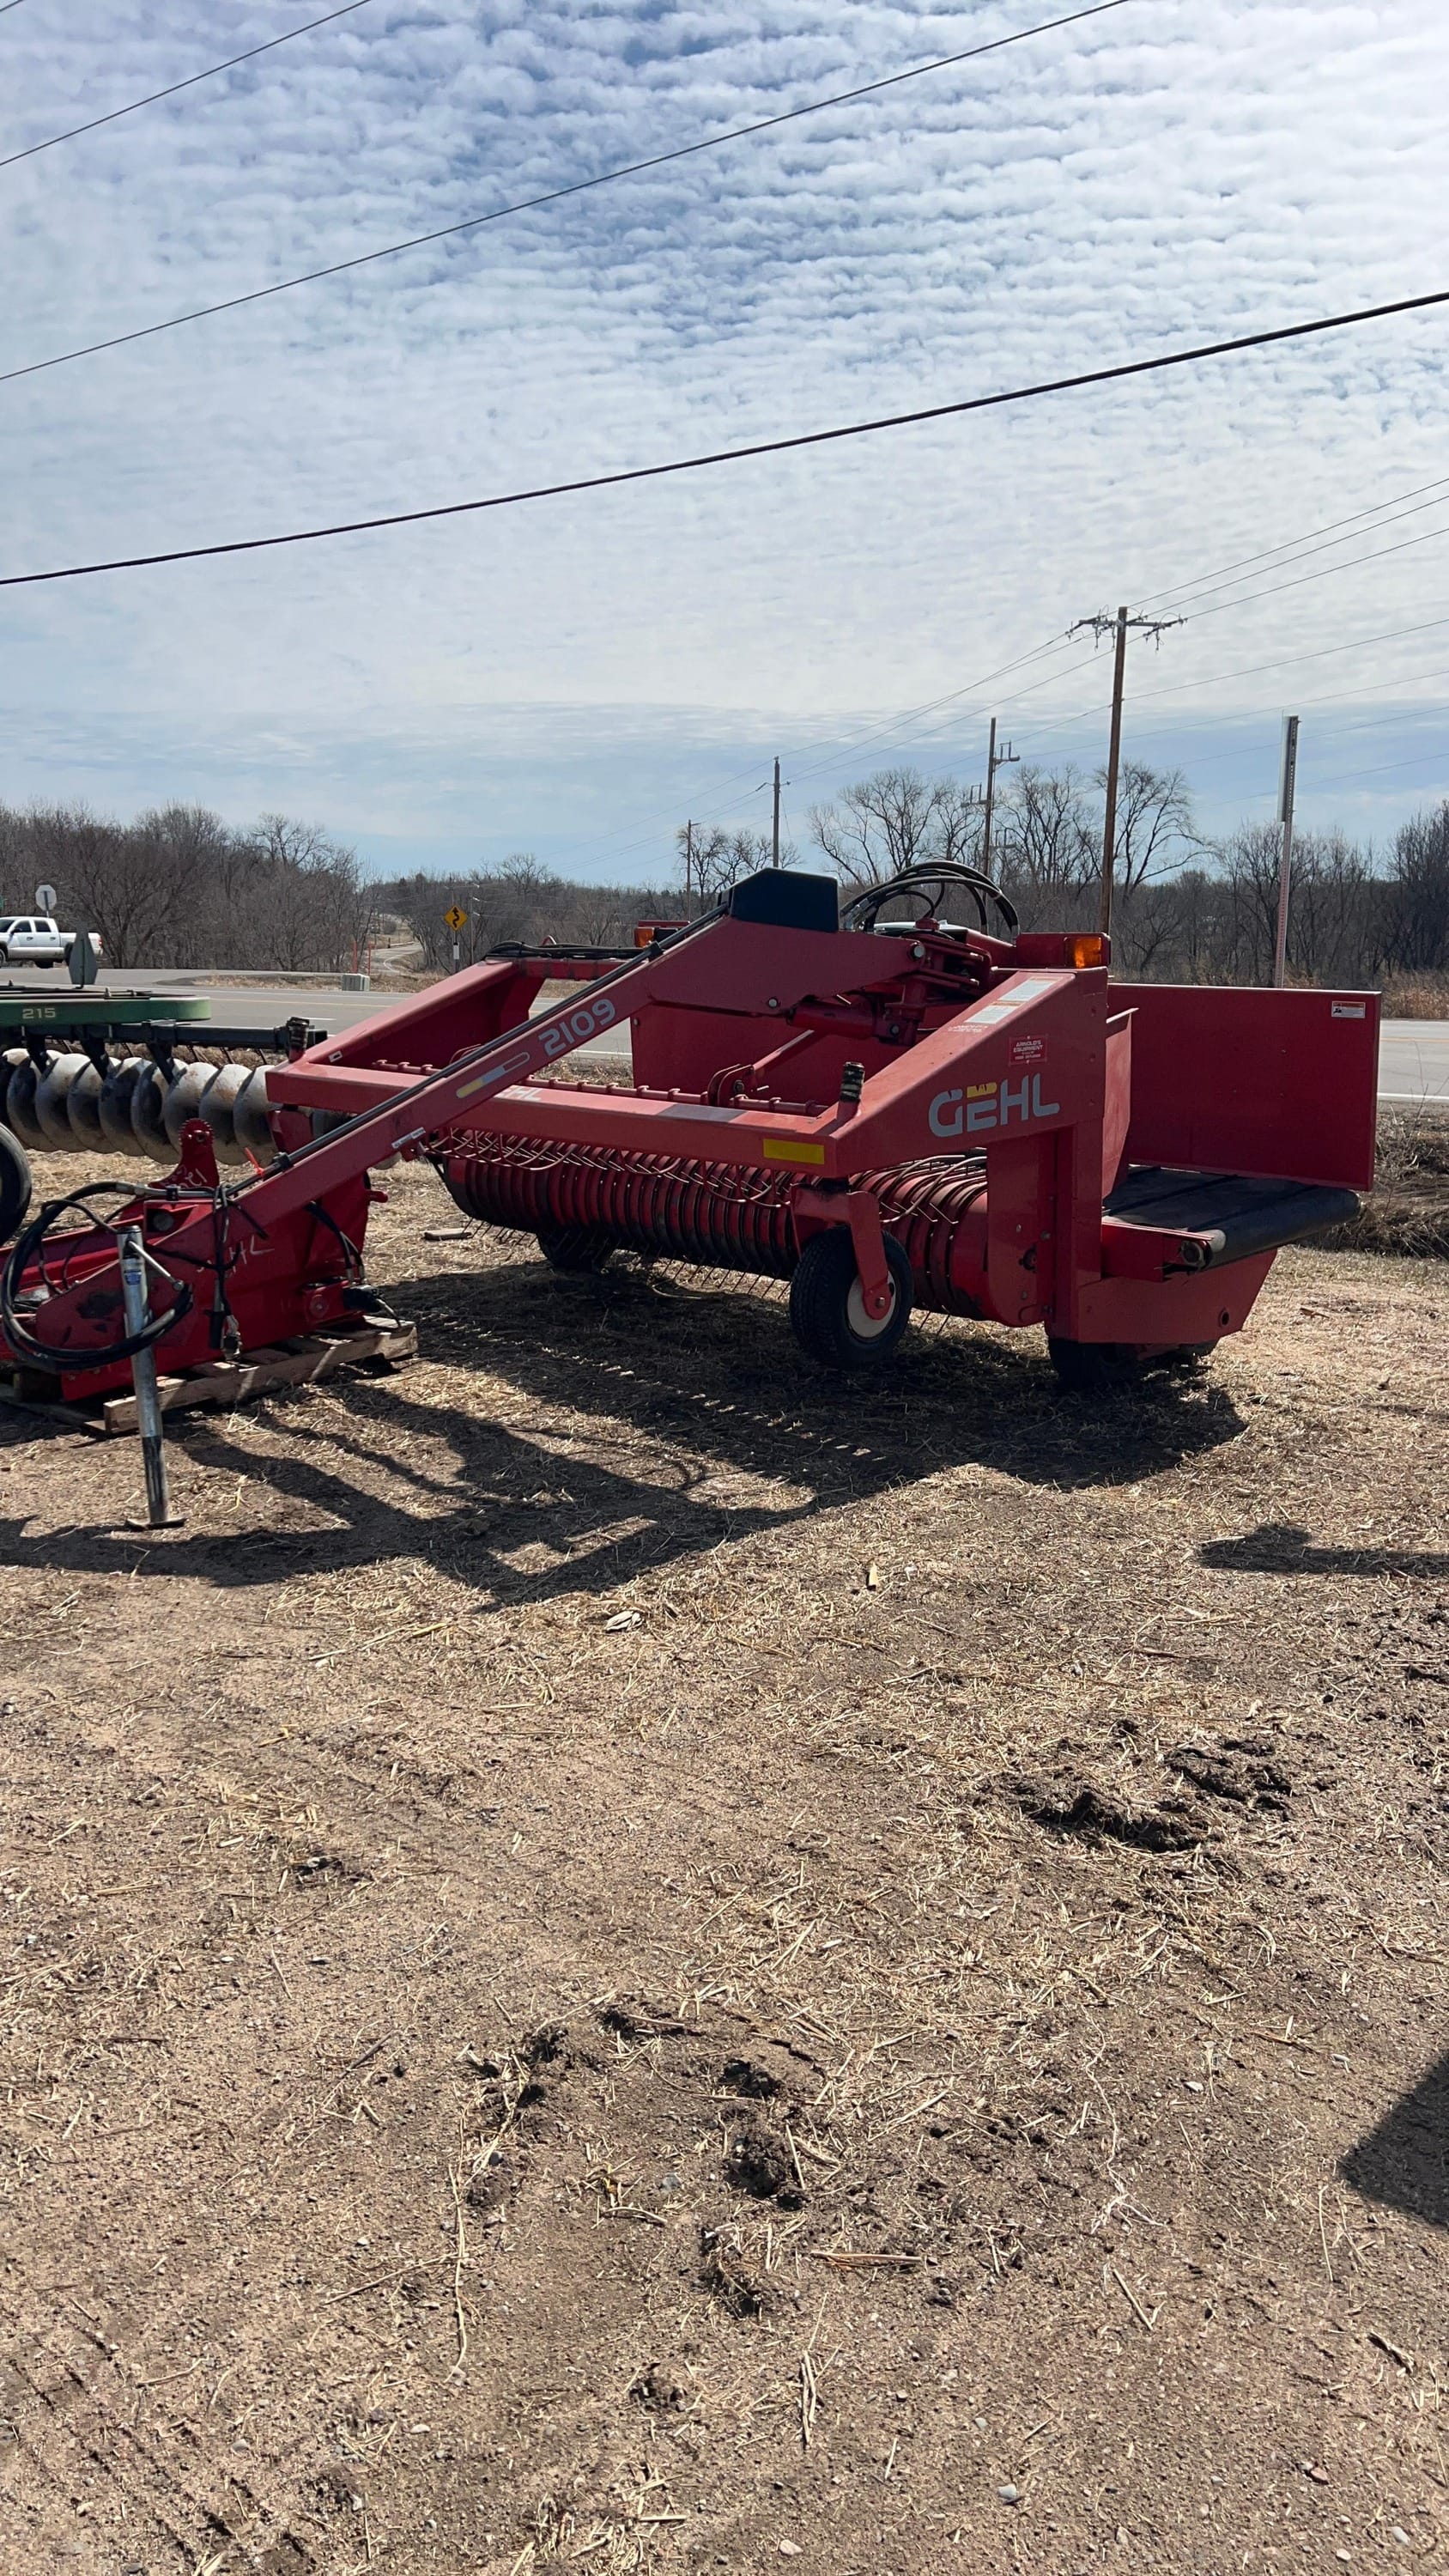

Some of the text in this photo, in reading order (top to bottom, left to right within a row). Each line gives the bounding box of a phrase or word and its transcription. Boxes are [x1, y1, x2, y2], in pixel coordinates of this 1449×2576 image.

[22, 1007, 57, 1019] 215
[538, 999, 615, 1056] 2109
[929, 1073, 1060, 1138] GEHL
